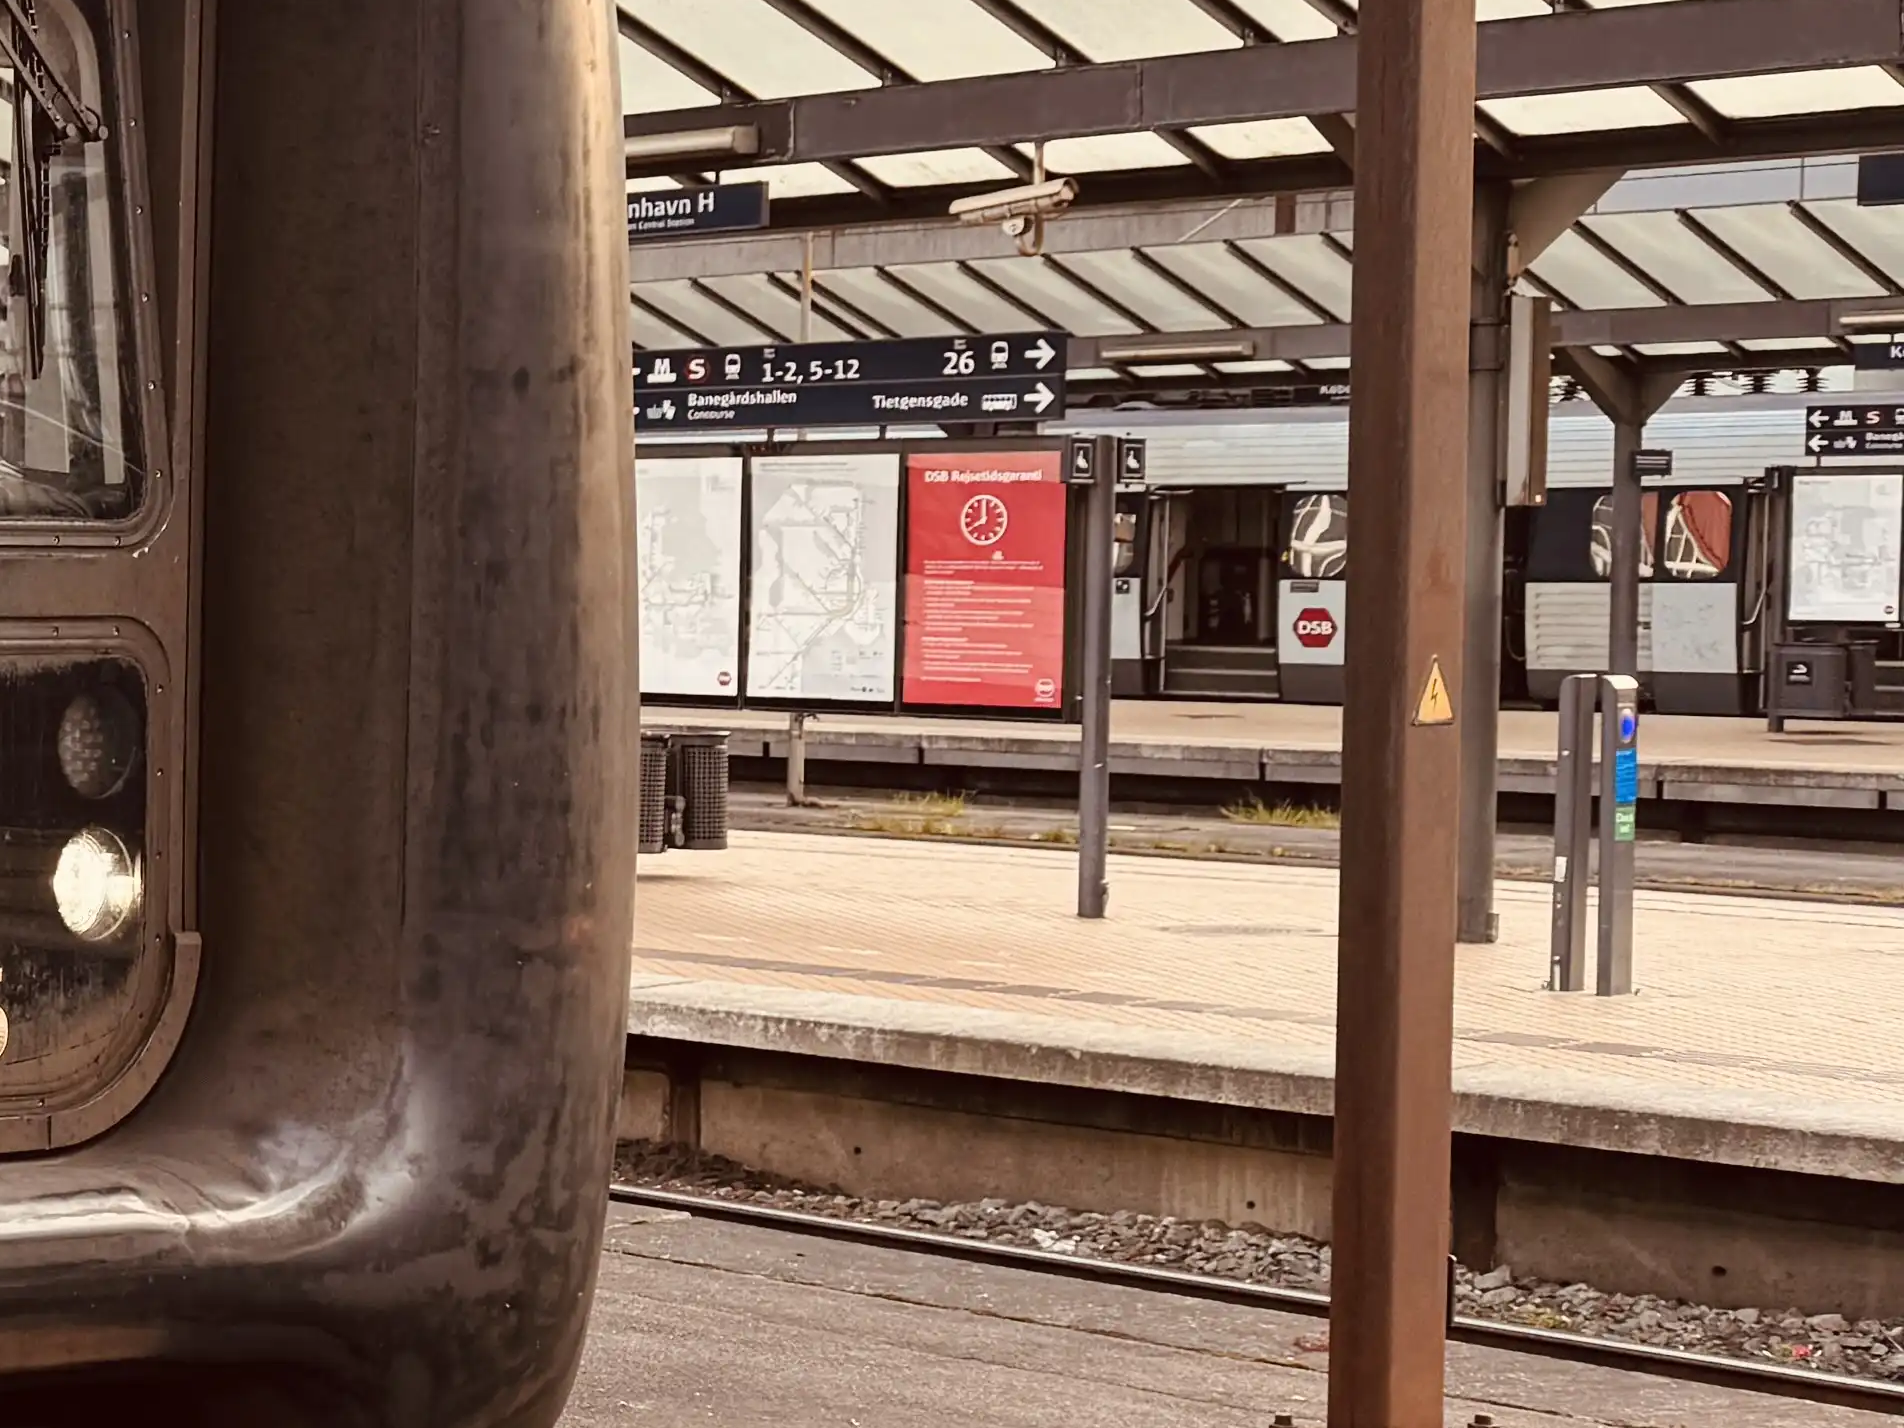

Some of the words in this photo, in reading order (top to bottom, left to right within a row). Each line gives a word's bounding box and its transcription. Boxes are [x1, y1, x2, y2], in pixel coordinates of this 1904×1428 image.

[698, 191, 715, 213] H
[1890, 346, 1904, 359] K
[809, 358, 861, 381] 5-12
[942, 351, 975, 375] 26
[687, 389, 798, 408] Banegårdshallen
[872, 392, 969, 410] Tietgensgade
[1296, 619, 1333, 636] DSB
